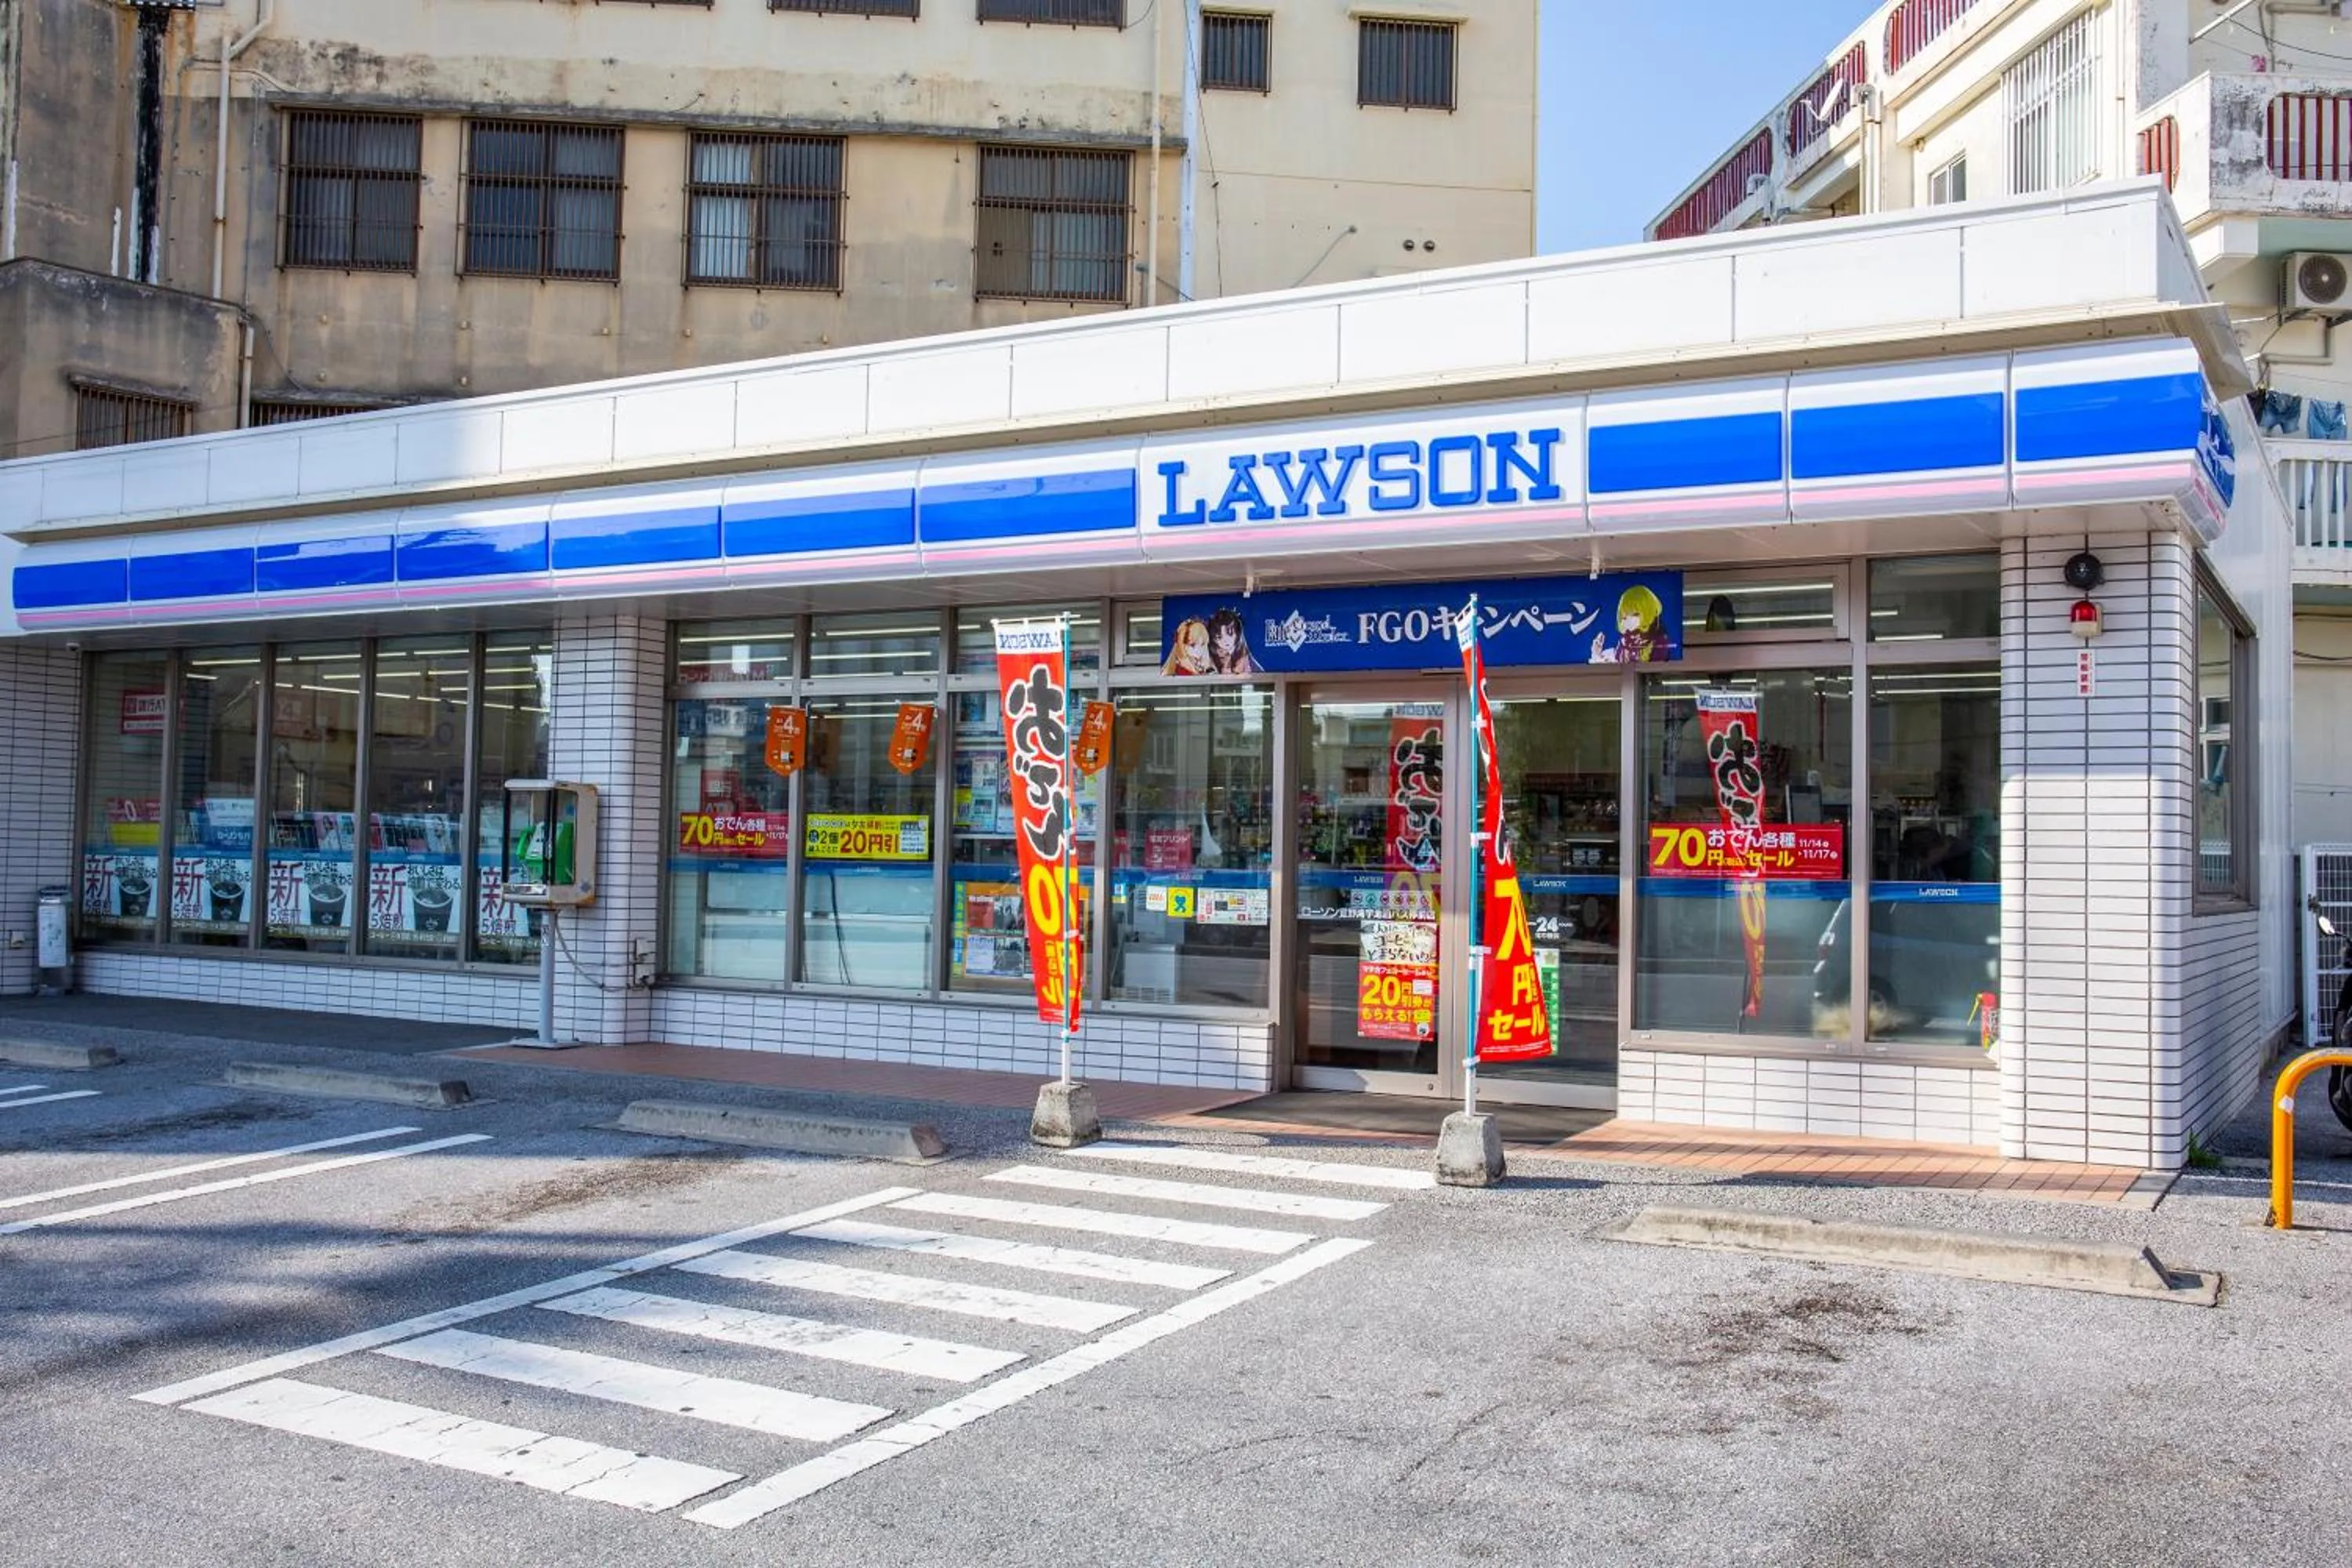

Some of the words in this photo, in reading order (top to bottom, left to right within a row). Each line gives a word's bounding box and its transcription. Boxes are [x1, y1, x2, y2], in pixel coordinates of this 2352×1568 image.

[1158, 427, 1560, 527] LAWSON
[1357, 602, 1600, 644] FGOキンペーン
[681, 815, 714, 846] 70
[840, 829, 899, 854] 20円引
[1652, 827, 1706, 866] 70
[1708, 829, 1795, 848] おでん各種
[86, 856, 114, 899] 新
[174, 858, 205, 904] 新
[270, 860, 303, 909] 新
[371, 863, 407, 914] 新
[1536, 916, 1559, 932] 24
[1362, 975, 1401, 1007] 20
[1512, 963, 1533, 1005] 円
[1487, 1003, 1545, 1040] セール
